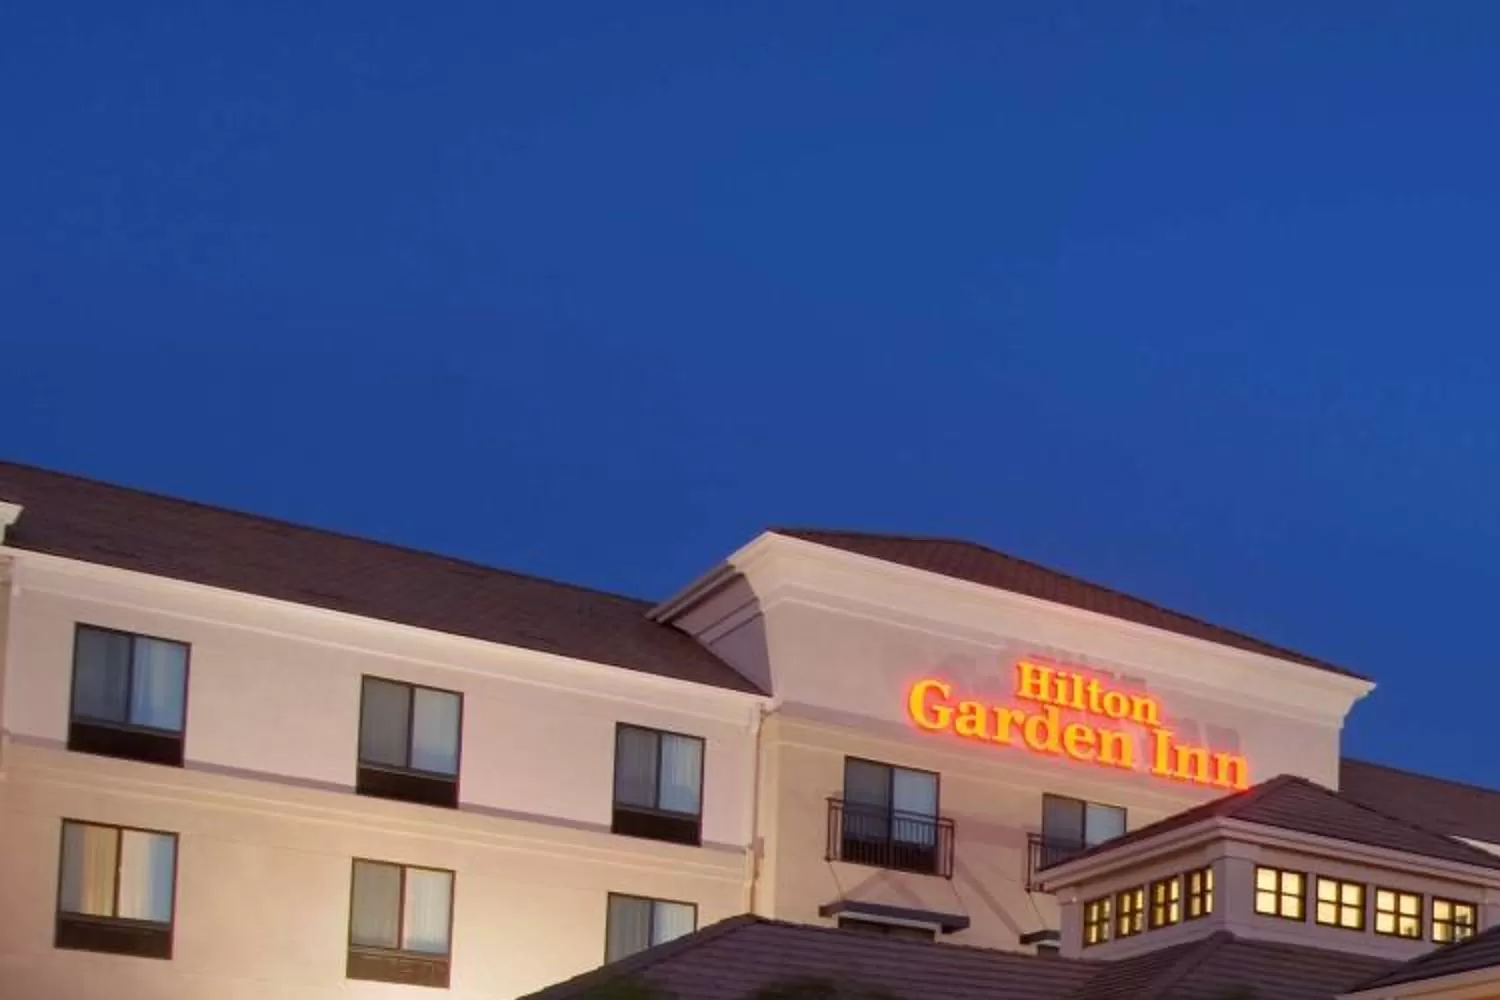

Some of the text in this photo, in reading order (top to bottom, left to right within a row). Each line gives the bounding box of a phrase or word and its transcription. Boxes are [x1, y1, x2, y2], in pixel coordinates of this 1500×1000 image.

[908, 678, 1248, 790] Garden Inn
[1016, 660, 1161, 725] Hilton
